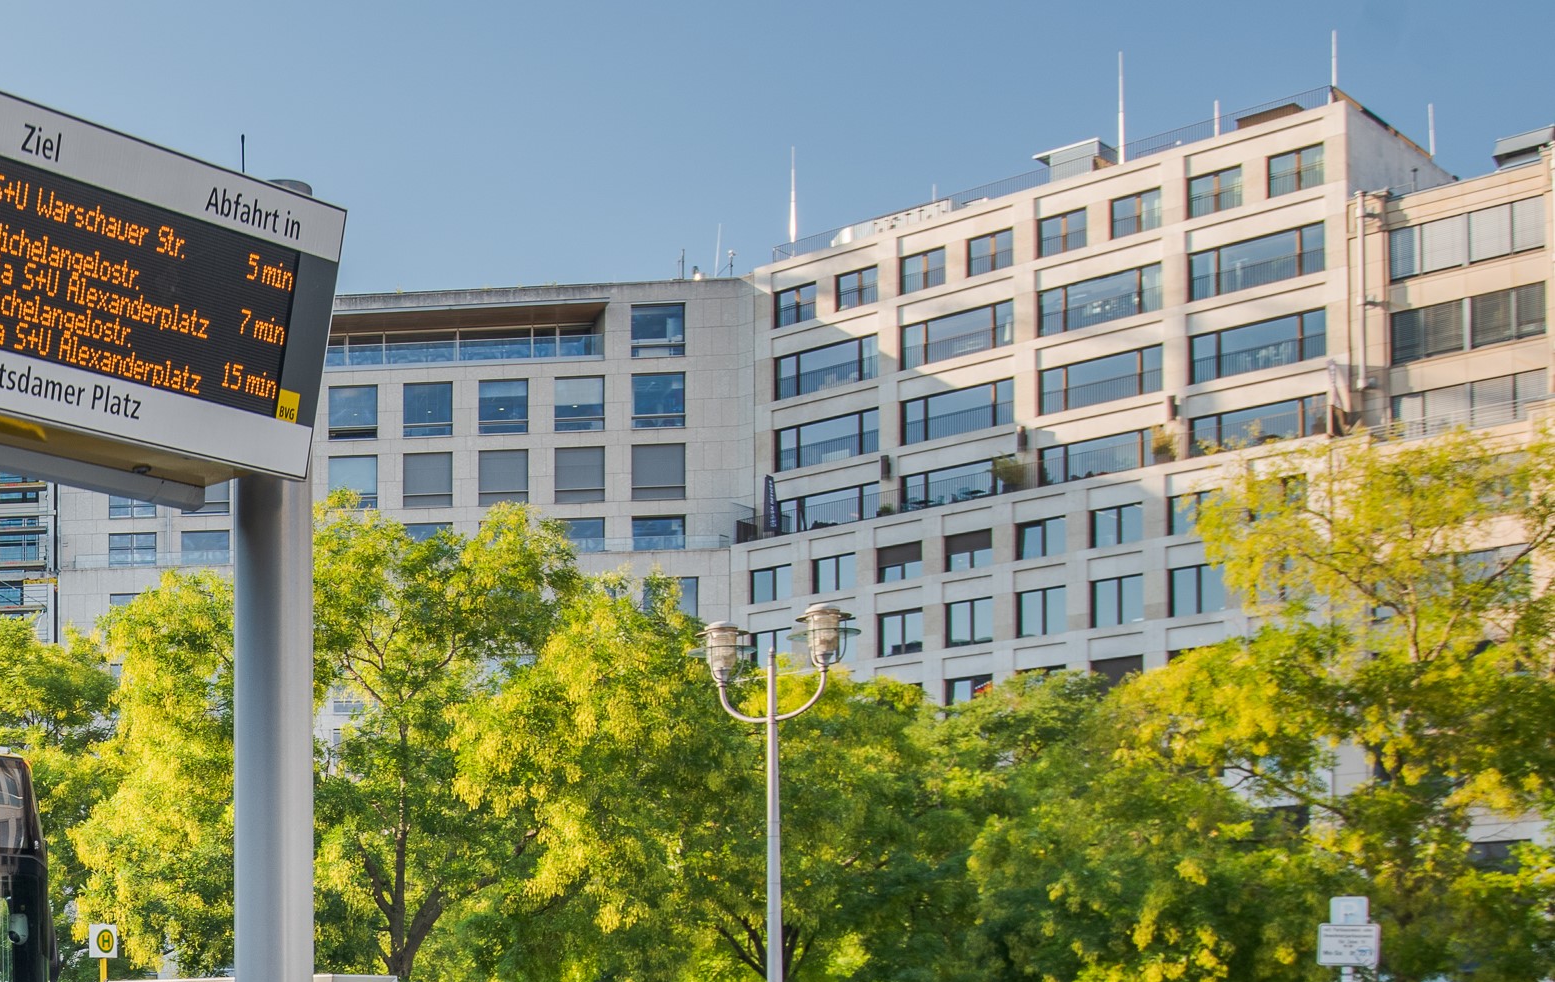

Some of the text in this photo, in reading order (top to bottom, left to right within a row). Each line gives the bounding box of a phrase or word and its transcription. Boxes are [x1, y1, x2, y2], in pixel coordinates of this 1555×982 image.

[21, 122, 62, 162] Ziel
[36, 187, 149, 247] Warschauer
[156, 225, 186, 260] Str.
[205, 187, 301, 240] Abfahrt in
[246, 252, 293, 292] 5 min
[22, 262, 60, 297] S+U
[66, 271, 210, 339] Alexanderplatz
[240, 308, 285, 346] 7 min
[14, 321, 52, 356] S+U
[58, 329, 202, 395] Alexanderplatz
[221, 361, 277, 400] 15 min
[91, 384, 142, 420] Platz
[278, 405, 295, 421] BVG
